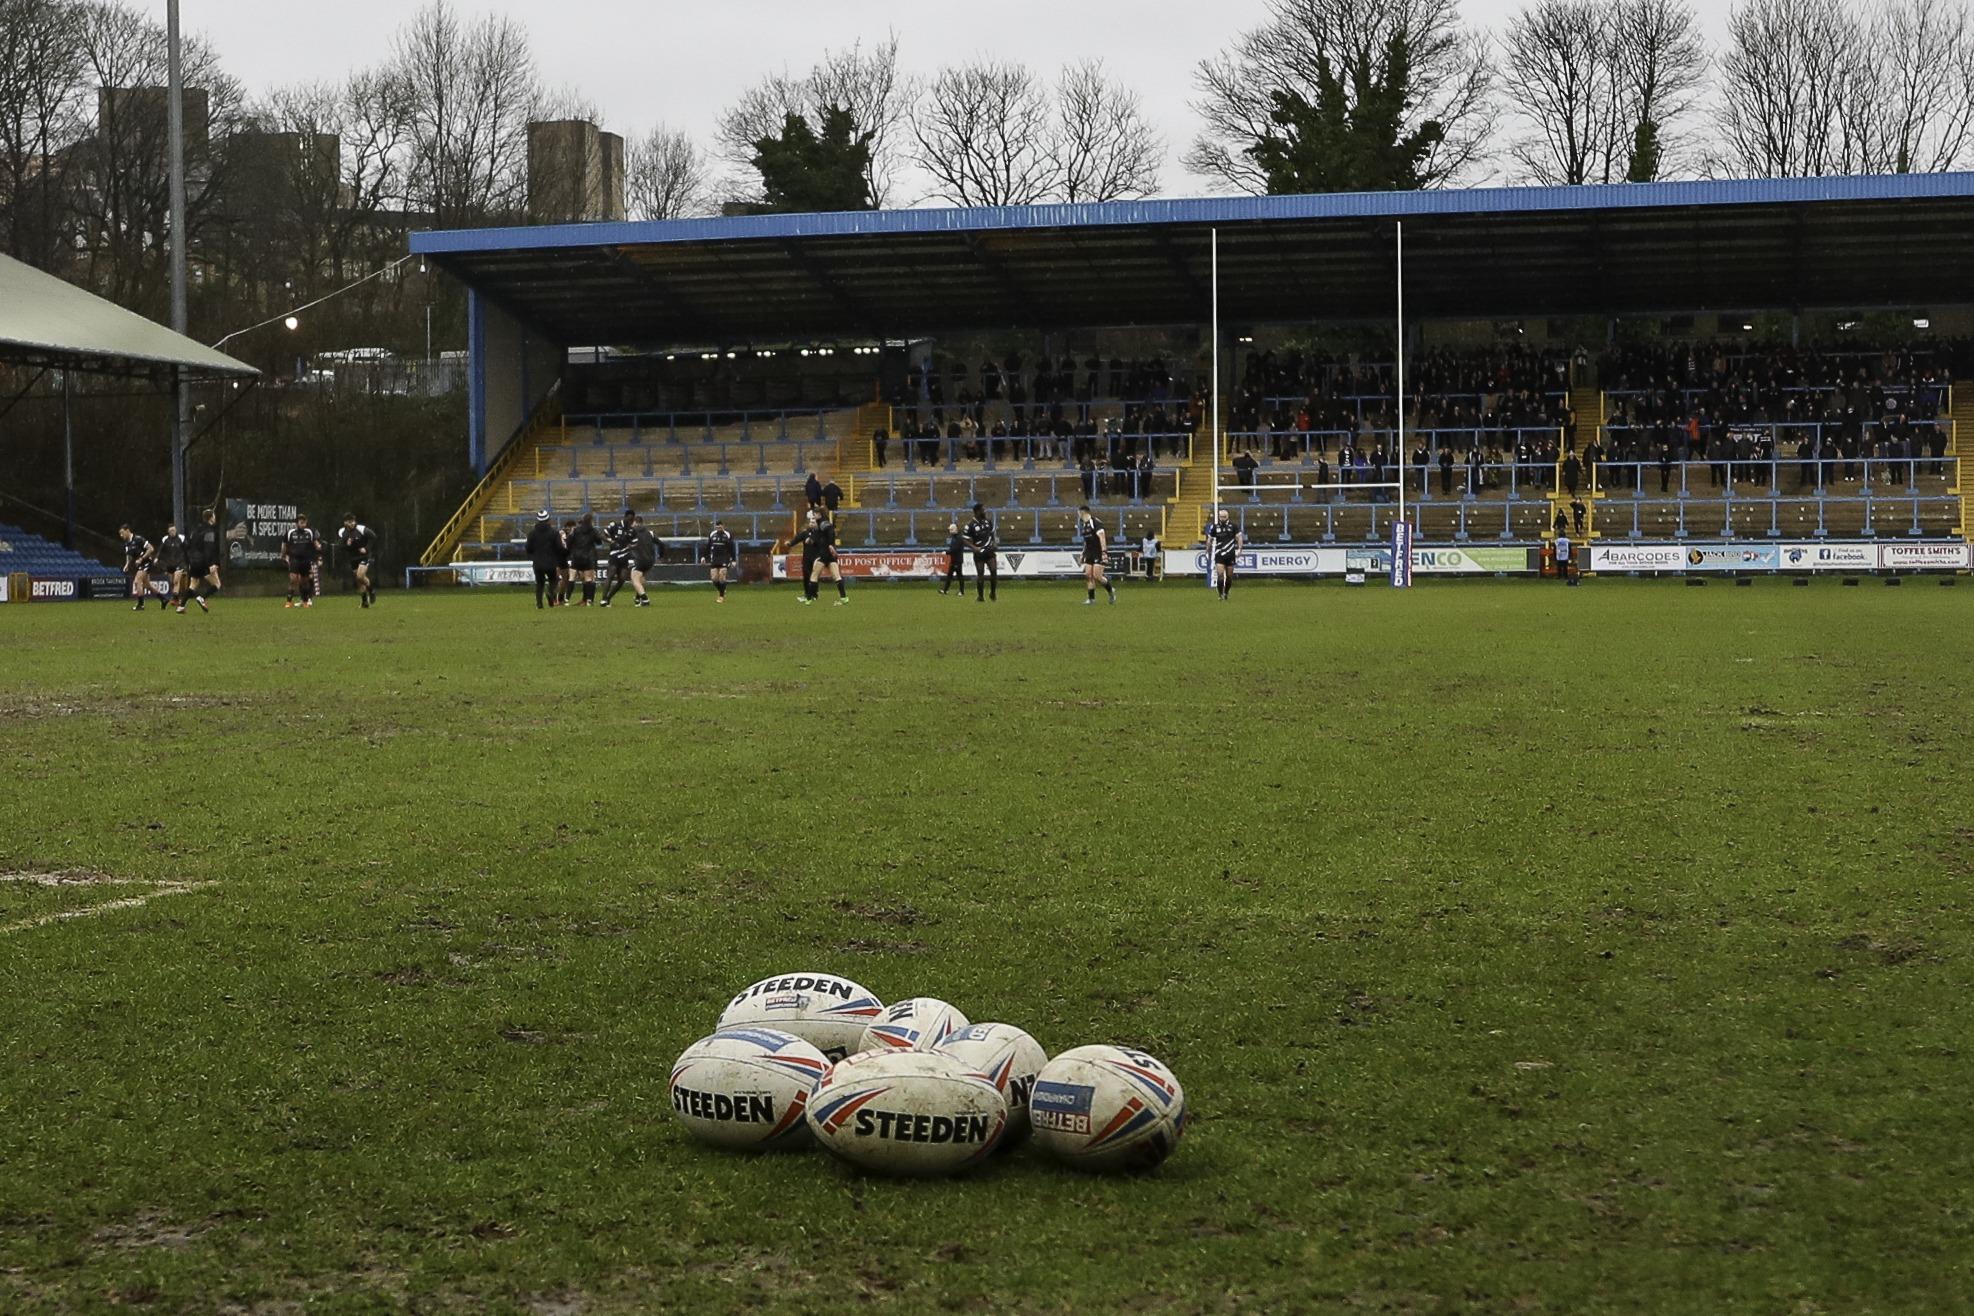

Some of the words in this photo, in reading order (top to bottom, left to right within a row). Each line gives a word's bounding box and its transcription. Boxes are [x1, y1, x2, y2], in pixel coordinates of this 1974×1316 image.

[247, 504, 256, 519] BE
[257, 504, 276, 519] MORE
[278, 505, 297, 519] THAN
[252, 521, 257, 536] A
[1393, 523, 1405, 587] BETFRED
[1833, 552, 1865, 560] facebook
[1891, 547, 1925, 555] TOFFEE
[854, 558, 877, 566] POST
[879, 557, 912, 566] OFFICE
[1261, 556, 1311, 566] ENERGY
[32, 581, 74, 596] BETFRED
[734, 977, 853, 1007] STEEDEN
[673, 1084, 776, 1123] STEEDEN
[855, 1108, 989, 1144] STEEDEN
[1033, 1110, 1088, 1132] BETFRE
